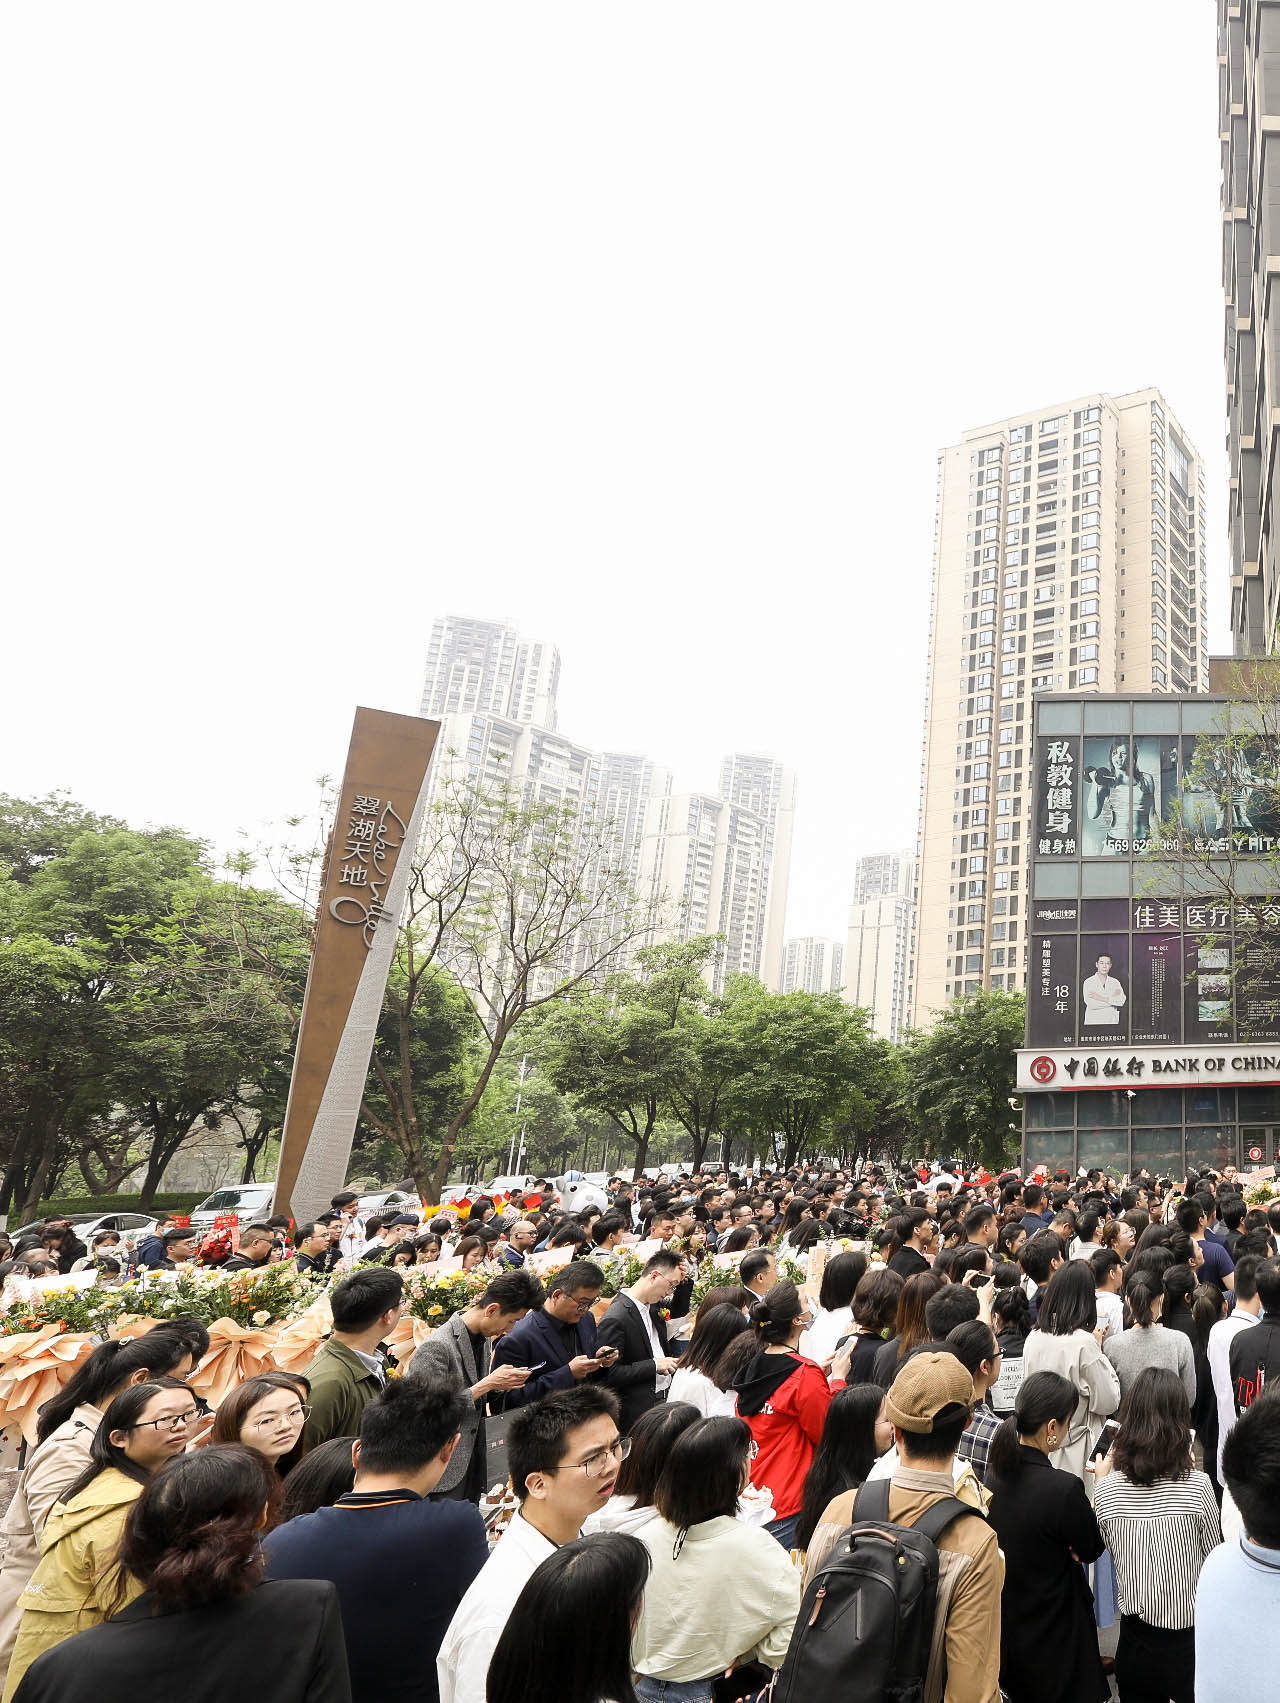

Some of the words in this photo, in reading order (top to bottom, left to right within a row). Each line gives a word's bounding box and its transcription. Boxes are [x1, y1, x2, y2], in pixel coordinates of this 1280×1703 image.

[1046, 741, 1074, 833] 私教健身
[338, 795, 380, 886] 翠湖天地
[1063, 1056, 1146, 1080] 中国银行
[1151, 1058, 1200, 1074] BANK
[1204, 1058, 1226, 1072] OF
